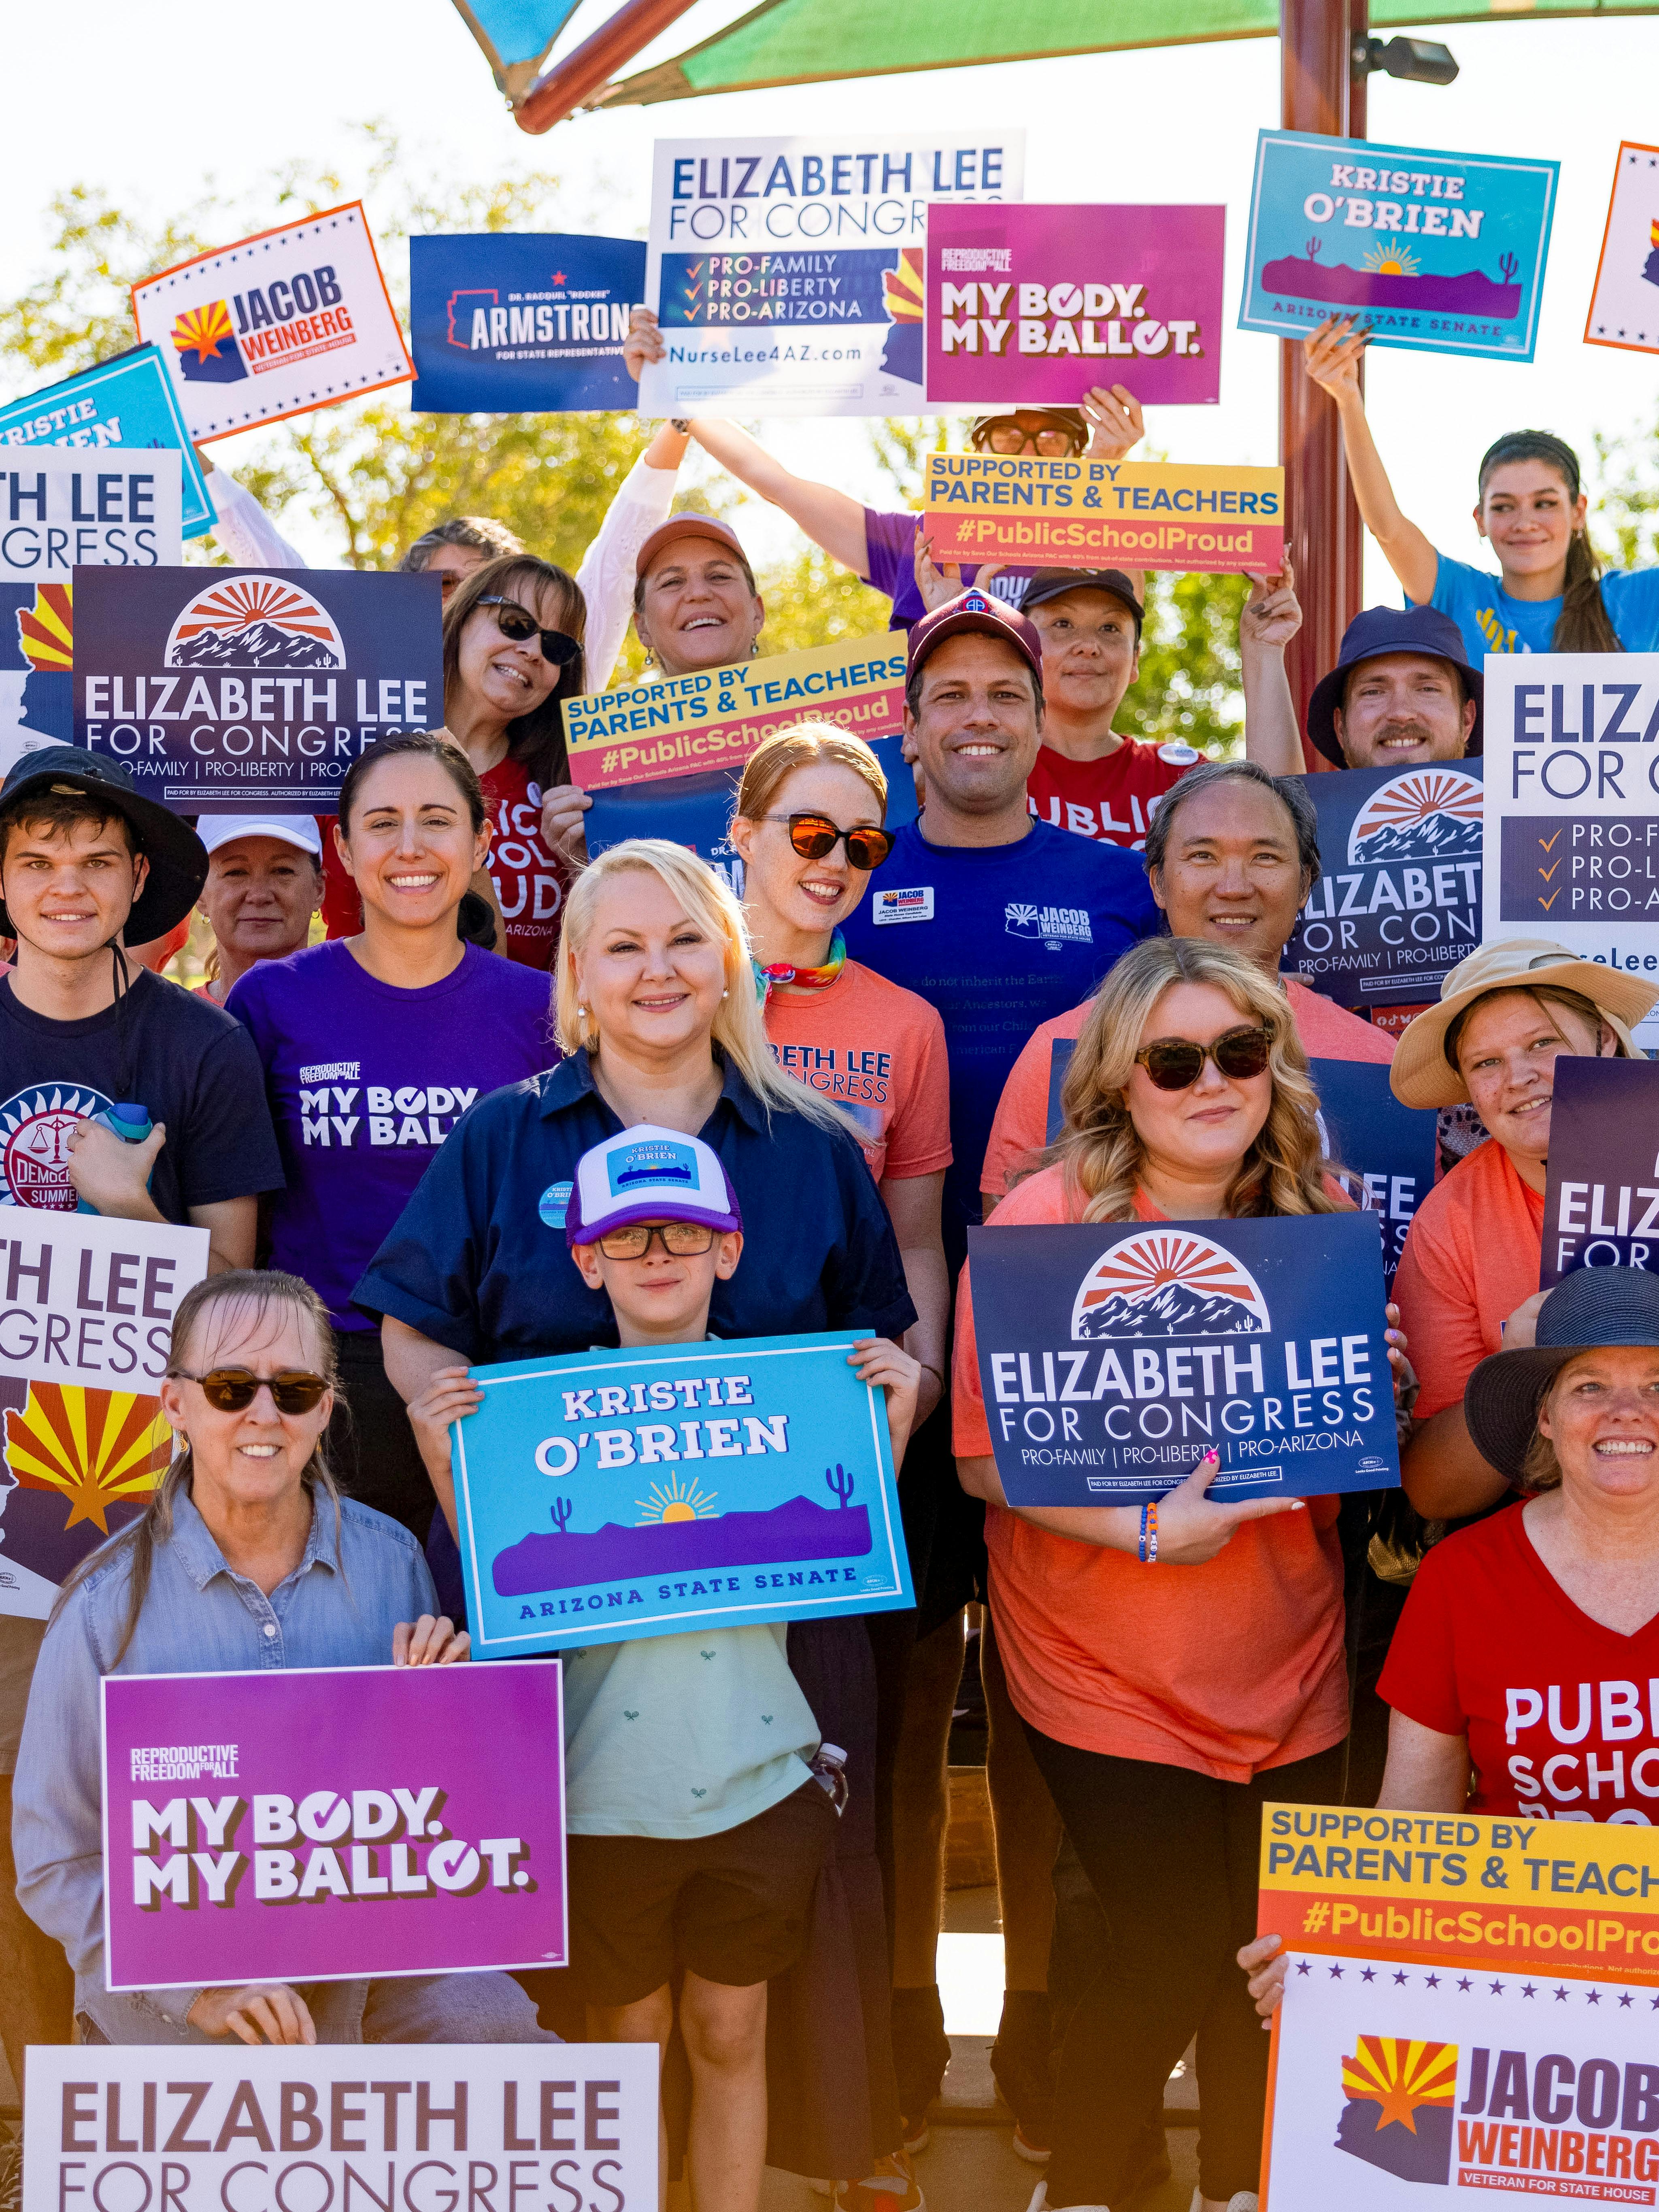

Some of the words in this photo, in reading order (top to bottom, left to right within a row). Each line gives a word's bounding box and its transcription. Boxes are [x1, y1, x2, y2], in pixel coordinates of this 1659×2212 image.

[673, 152, 912, 199] ELIZABETH
[933, 148, 1003, 191] LEE
[1330, 164, 1465, 200] KRISTIE
[669, 204, 749, 240] FOR
[1303, 191, 1485, 238] O'BRIEN
[708, 254, 838, 276] PRO-FAMILY
[941, 248, 1012, 260] REPRODUCTIVE
[941, 258, 987, 272] FREEDOM
[993, 259, 1012, 272] ALL
[234, 266, 341, 334] JACOB
[707, 277, 842, 299] PRO-LIBERTY
[941, 282, 1013, 317] MY
[1018, 283, 1146, 318] BODY.
[470, 303, 647, 351] ARMSTRON
[706, 300, 863, 321] PRO-ARIZONA
[1363, 313, 1421, 329] STATE
[1429, 319, 1503, 336] SENATE
[240, 307, 353, 361] WEINBERG
[941, 318, 1013, 353] MY
[1018, 319, 1201, 355] BALLOT.
[288, 352, 304, 362] FOR
[496, 351, 515, 360] FOR
[516, 349, 546, 359] STATE
[669, 345, 861, 364] NurseLee4AZ.com
[932, 458, 1081, 481] SUPPORTED
[1089, 460, 1122, 482] BY
[72, 473, 154, 523] LEE
[931, 479, 1073, 508] PARENTS
[1083, 485, 1103, 509] &
[1113, 485, 1279, 515] TEACHERS
[955, 519, 1253, 553] #PublicSchoolProud
[86, 676, 338, 723] ELIZABETH
[357, 679, 428, 724] LEE
[568, 675, 712, 719] SUPPORTED
[719, 667, 750, 688] BY
[569, 696, 710, 744] PARENTS
[717, 690, 738, 713] &
[745, 655, 908, 707] TEACHERS
[87, 724, 166, 755] FOR
[205, 761, 294, 777] PRO-LIBERTY
[1512, 749, 1626, 800] FOR
[898, 890, 924, 899] JACOB
[1299, 861, 1482, 921] LIZABET
[506, 923, 552, 936] ARIZONA
[1039, 906, 1090, 926] JACOB
[1040, 921, 1092, 937] WEINBERG
[1299, 952, 1381, 973] PRO-FAMILY
[1391, 976, 1415, 985] ELIZABETH
[300, 1062, 361, 1076] REPRODUCTIVE
[300, 1071, 338, 1084] FREEDOM
[345, 1070, 361, 1080] ALL
[847, 1051, 891, 1079] LEE
[299, 1087, 360, 1114] MY
[301, 1116, 361, 1146] MY
[625, 1152, 677, 1163] O'BRIEN
[632, 1145, 670, 1154] KRISTIE
[621, 1179, 647, 1188] ARIZONA
[1557, 1238, 1650, 1272] FOR
[77, 1249, 177, 1320] LEE
[991, 1343, 1265, 1402] ELIZABETH
[1284, 1334, 1372, 1391] LEE
[562, 1374, 753, 1422] KRISTIE
[999, 1406, 1083, 1442] FOR
[1104, 1387, 1375, 1440] CONGRESS
[534, 1414, 789, 1477] O'BRIEN
[1021, 1447, 1106, 1466] PRO-FAMILY
[1123, 1442, 1220, 1464] PRO-LIBERTY
[1239, 1429, 1364, 1458] PRO-ARIZONA
[1239, 1471, 1267, 1480] ELIZABETH
[1267, 1470, 1278, 1478] LEE.
[519, 1587, 645, 1619] ARIZONA
[657, 1576, 740, 1599] STATE
[754, 1567, 857, 1589] SENATE
[131, 1744, 239, 1766] REPRODUCTIVE
[131, 1762, 201, 1781] FREEDOM
[200, 1762, 215, 1771] FOR
[213, 1759, 239, 1778] ALL
[132, 1795, 241, 1850] MY
[253, 1786, 445, 1844] BODY.
[1270, 1810, 1480, 1848] SUPPORTED
[1491, 1823, 1537, 1850] BY
[133, 1851, 242, 1906] MY
[254, 1837, 531, 1900] BALLOT.
[1268, 1842, 1468, 1886] PARENTS
[1480, 1855, 1510, 1889] &
[60, 2080, 468, 2153] ELIZABETH
[502, 2080, 621, 2152] LEE
[1458, 2119, 1659, 2182] WEINBERG
[59, 2161, 191, 2212] FOR
[220, 2160, 625, 2212] CONGRESS
[1464, 2172, 1525, 2188] VETERAN
[1528, 2179, 1556, 2191] FOR
[1559, 2182, 1600, 2197] STATE
[1604, 2186, 1650, 2201] HOUSE
